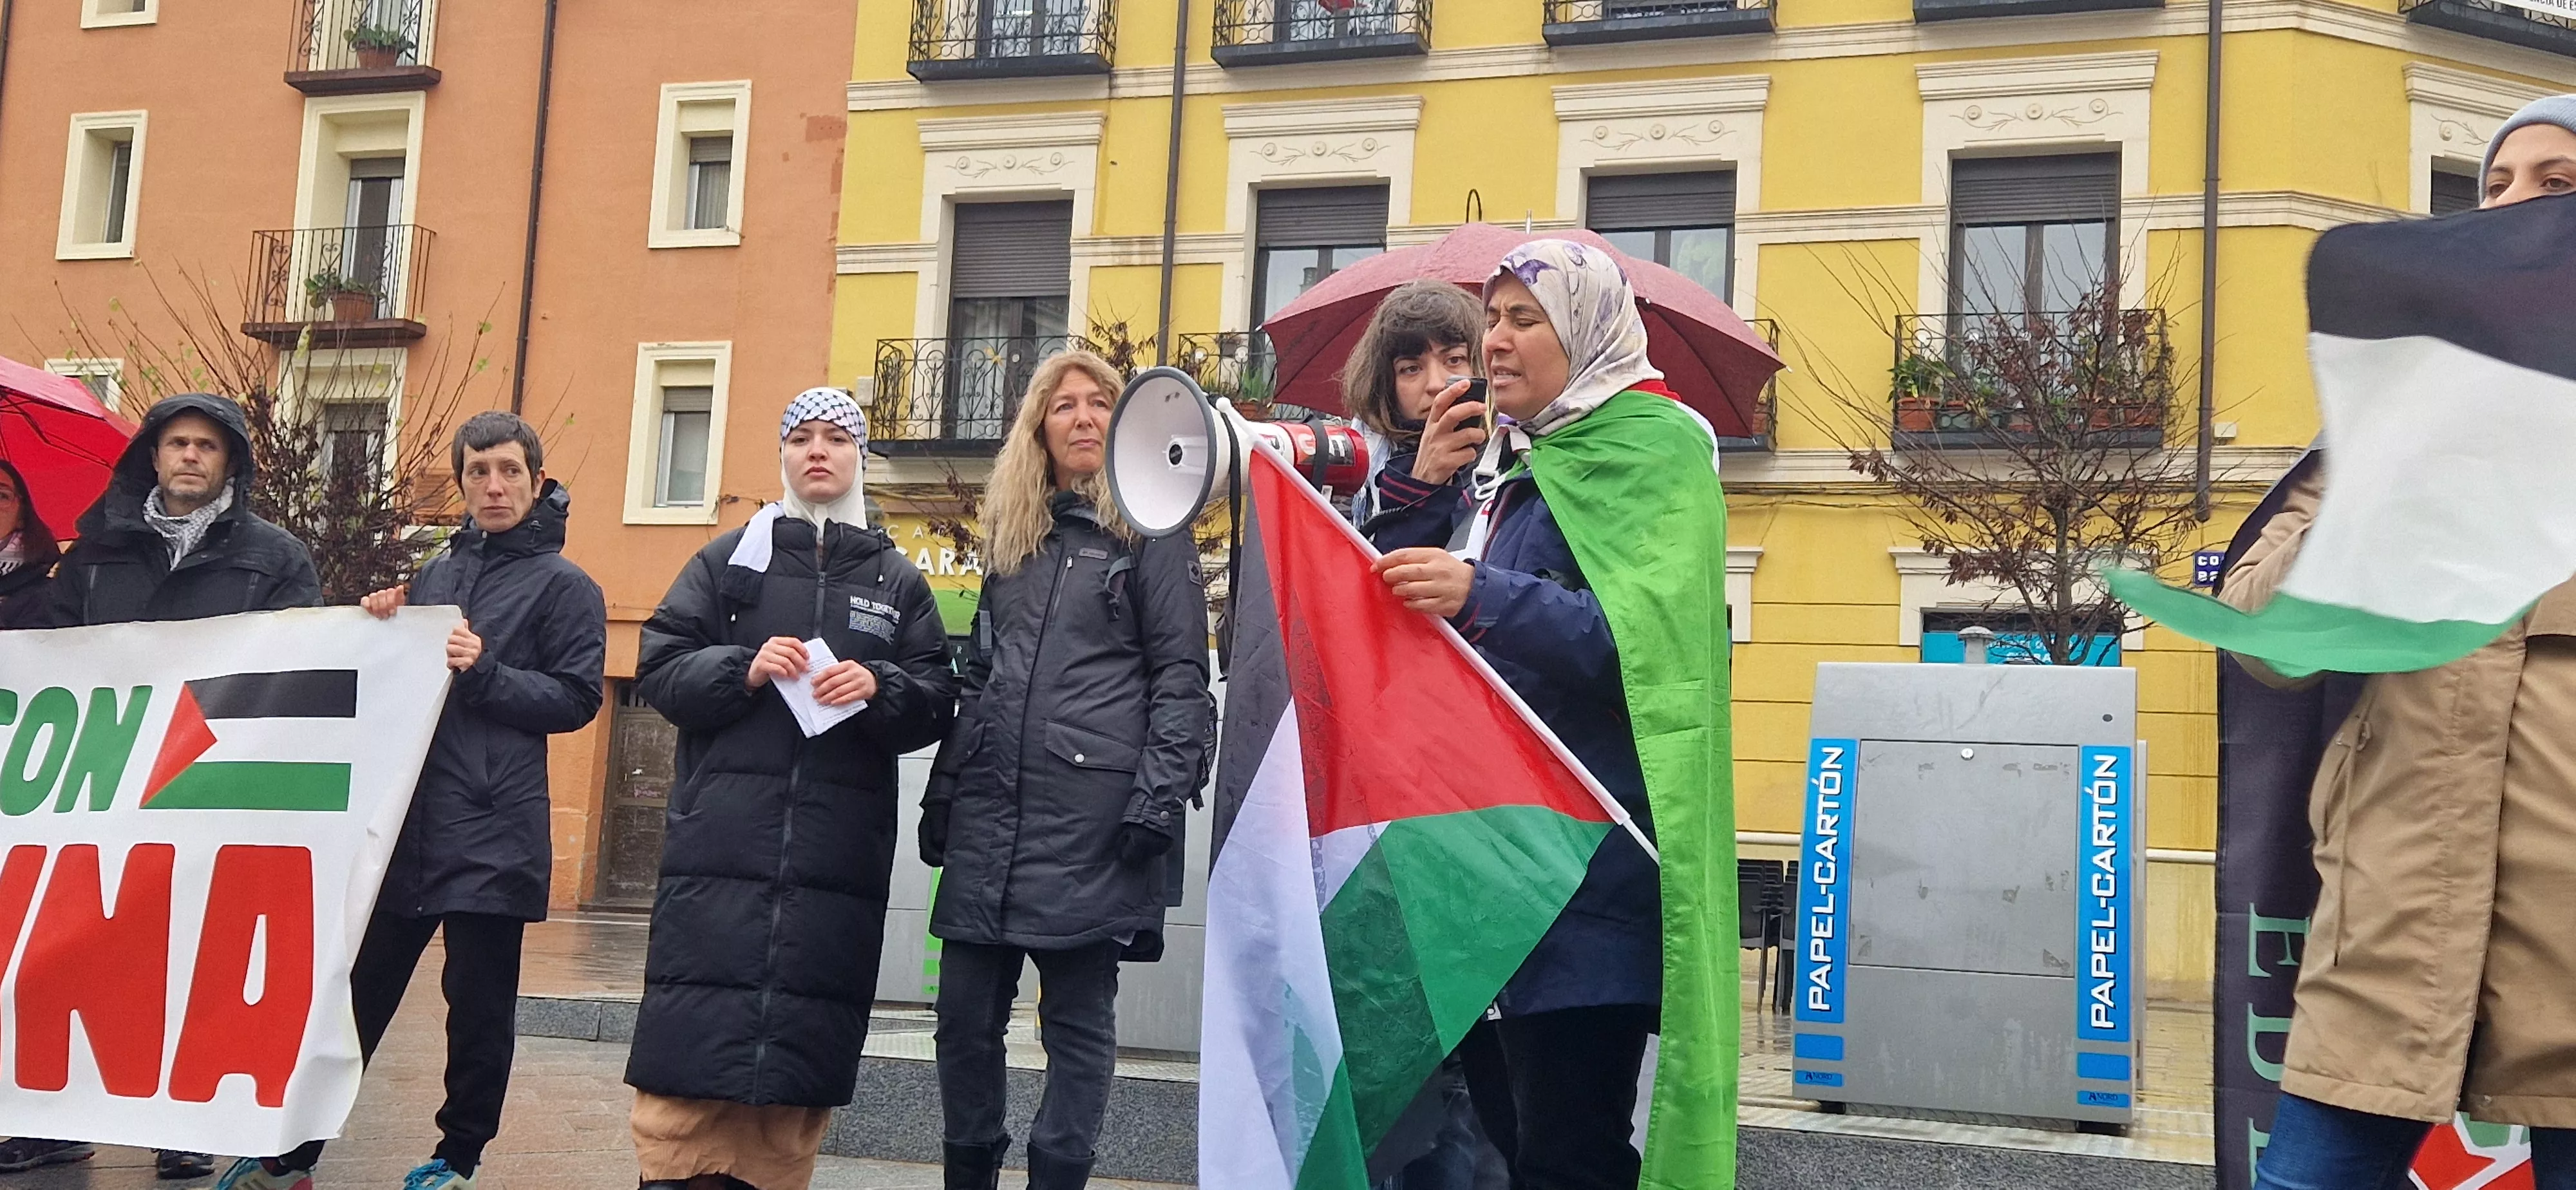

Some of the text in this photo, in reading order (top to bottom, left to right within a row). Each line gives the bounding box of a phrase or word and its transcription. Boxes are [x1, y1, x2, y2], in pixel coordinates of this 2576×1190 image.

[895, 545, 983, 576] ARA
[2197, 556, 2224, 566] CO
[850, 595, 869, 608] HOLD
[0, 685, 153, 816] ON
[1808, 747, 1844, 1011] PAPEL-CARTÓN
[2084, 754, 2117, 1028] PAPEL-CARTÓN
